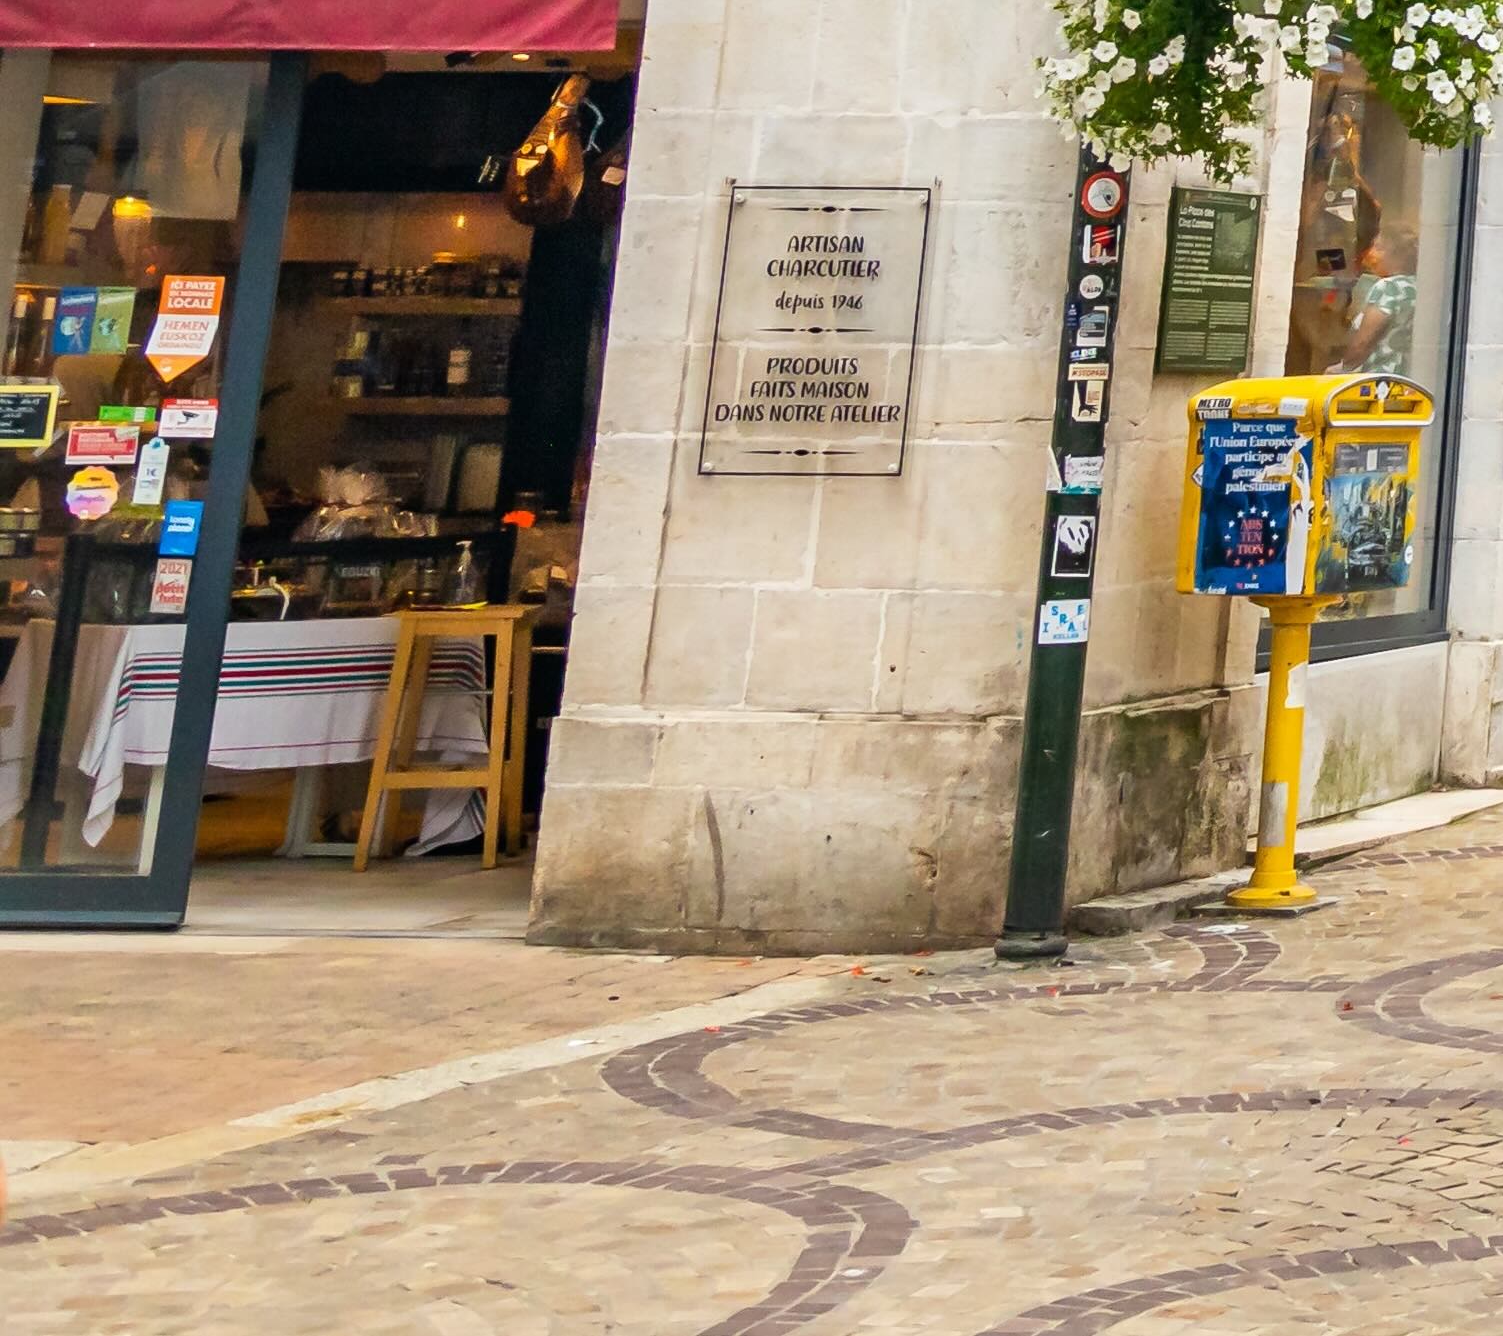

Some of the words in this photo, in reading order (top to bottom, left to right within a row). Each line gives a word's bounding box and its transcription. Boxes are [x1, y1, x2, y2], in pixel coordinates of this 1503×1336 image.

[787, 235, 865, 253] ARTISAN
[766, 259, 881, 281] CHARCUTIER
[186, 281, 216, 291] PAYEZ
[167, 297, 215, 309] LOCALE
[775, 290, 825, 315] depuis
[831, 293, 864, 311] 1946
[163, 320, 210, 332] HEMEN
[766, 357, 858, 376] PRODUITS
[750, 380, 797, 399] FAITS
[800, 380, 870, 399] MAISON
[1197, 398, 1232, 408] METRO
[715, 403, 765, 422] DANS
[769, 404, 826, 423] NOTRE
[830, 404, 901, 424] ATELIER
[1232, 422, 1263, 434] Parce
[1265, 423, 1287, 435] que
[1209, 435, 1247, 448] l'Union
[1224, 450, 1275, 465] participe
[1224, 480, 1286, 495] palestinien
[1240, 531, 1263, 543] TEN
[1238, 543, 1264, 555] TION
[159, 561, 188, 575] 2021
